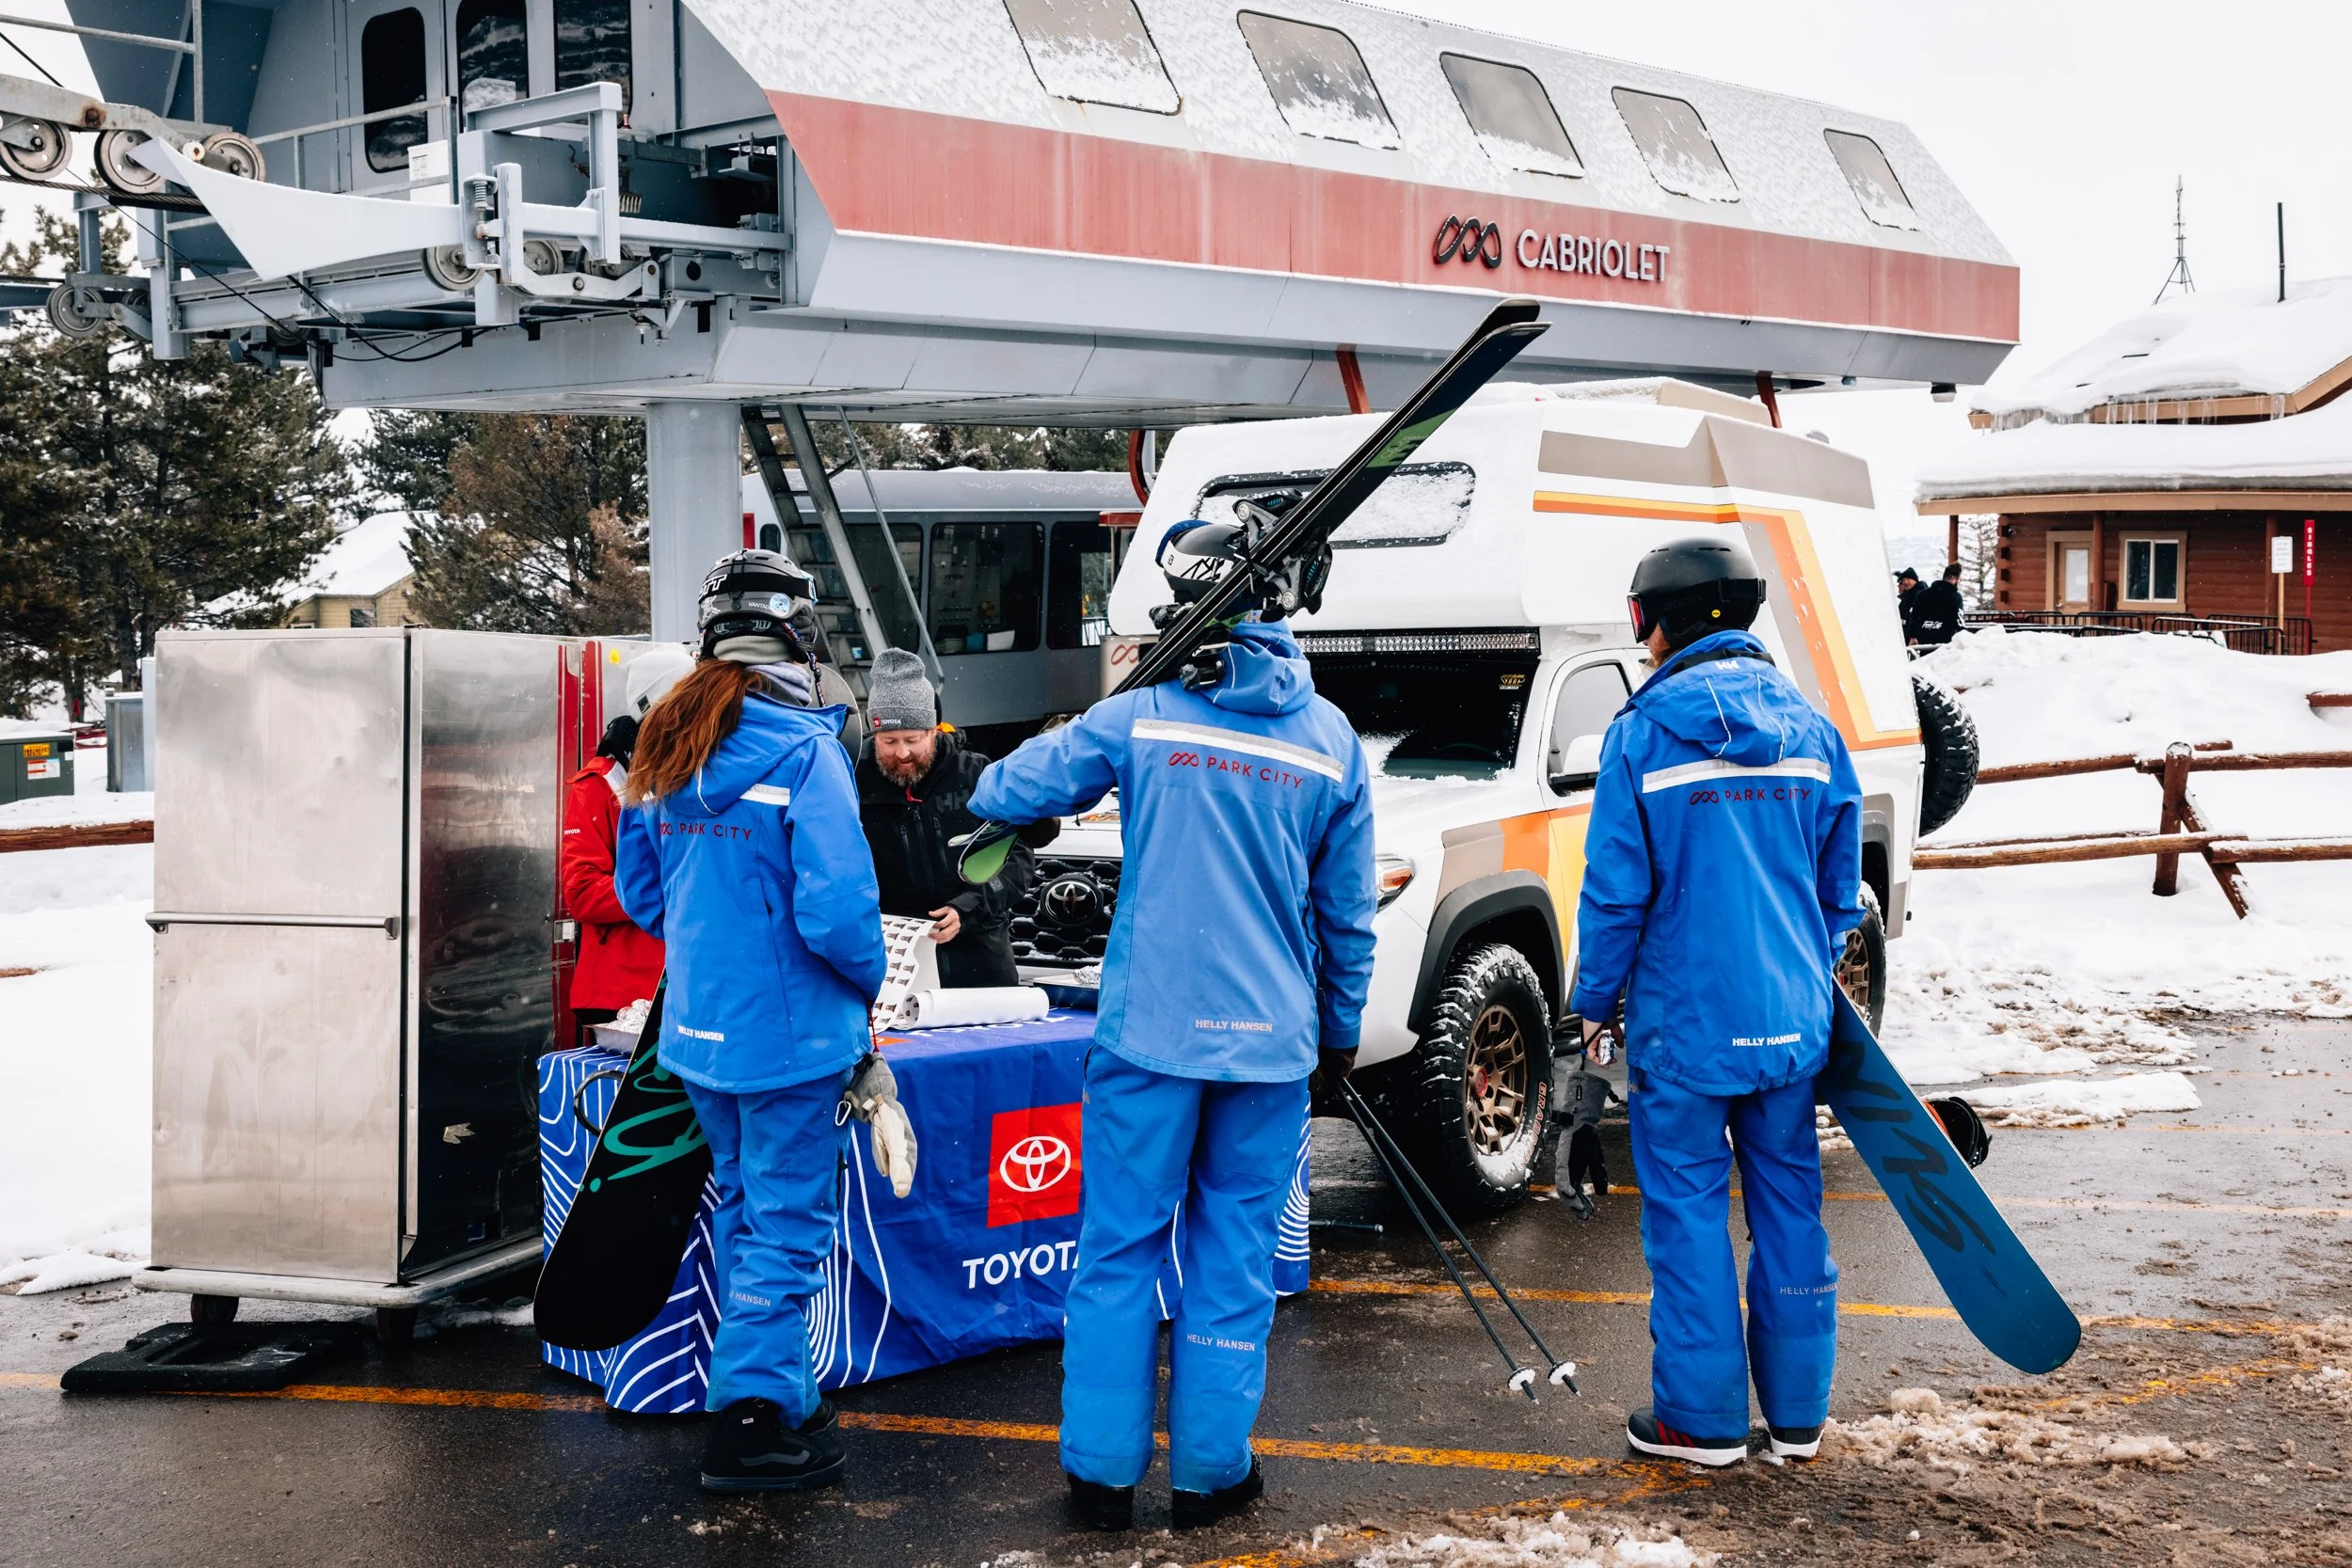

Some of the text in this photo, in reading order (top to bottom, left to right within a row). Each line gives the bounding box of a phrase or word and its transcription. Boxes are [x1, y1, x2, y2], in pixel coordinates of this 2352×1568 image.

[1517, 229, 1670, 282] CABRIOLET
[748, 601, 771, 610] VANTAG
[1207, 756, 1303, 788] PARK CITY
[1724, 787, 1811, 800] PARK CITY
[713, 824, 753, 840] CITY
[1195, 1019, 1273, 1033] HELLY HANSEN
[694, 1029, 724, 1042] HANSEN
[1732, 1033, 1802, 1047] HELLY HANSEN
[961, 1240, 1079, 1290] TOYOT
[1780, 1286, 1810, 1295] HELLY
[736, 1291, 771, 1307] HANSEN
[1186, 1333, 1256, 1352] HELLY HANSEN
